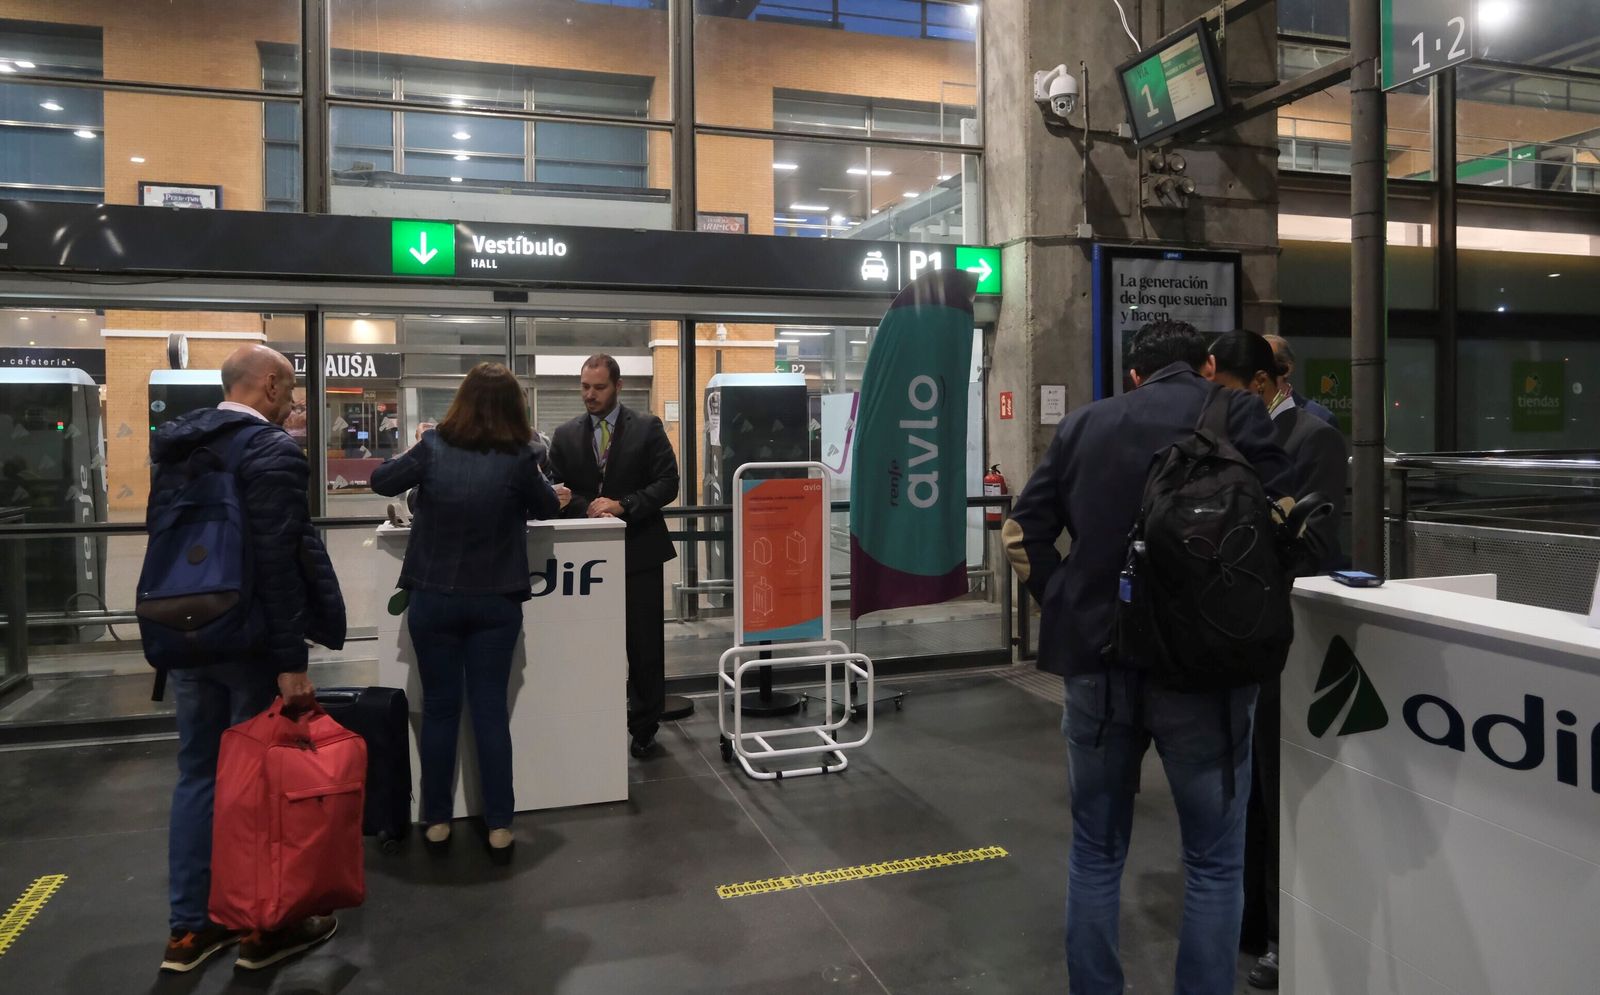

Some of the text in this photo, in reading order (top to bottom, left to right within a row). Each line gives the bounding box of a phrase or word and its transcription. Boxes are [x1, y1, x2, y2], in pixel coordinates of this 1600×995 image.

[1141, 83, 1159, 118] 1
[472, 234, 567, 256] Vestíbulo
[471, 258, 498, 269] HALL
[909, 250, 942, 281] P1
[1120, 273, 1208, 290] La generación
[1120, 290, 1228, 308] de los que sueñan
[1120, 311, 1129, 324] y
[326, 354, 378, 377] AUSA
[791, 363, 806, 375] P2
[1517, 394, 1560, 408] tiendas
[898, 374, 940, 509] avlo
[529, 558, 608, 597] dif
[880, 857, 941, 871] MANTENGA
[803, 869, 863, 882] DISTANCIA
[721, 880, 785, 895] SEGURIDAD
